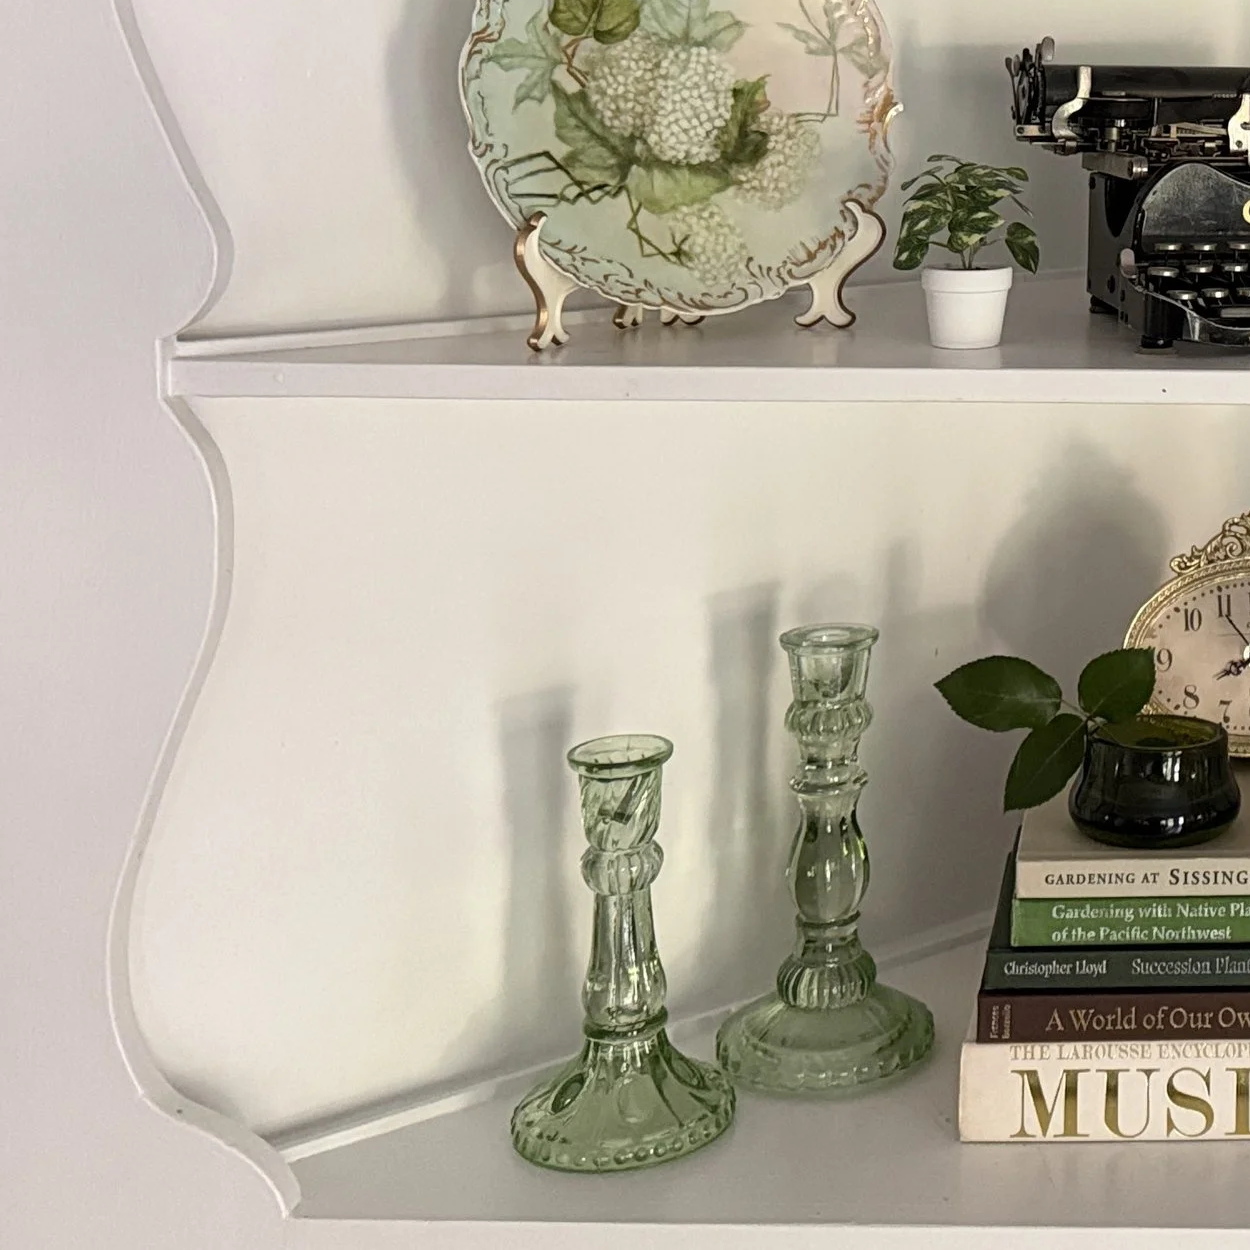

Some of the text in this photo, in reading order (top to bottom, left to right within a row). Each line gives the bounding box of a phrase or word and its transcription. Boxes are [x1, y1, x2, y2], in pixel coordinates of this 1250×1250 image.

[1217, 594, 1232, 618] 11
[1184, 608, 1202, 632] 10
[1157, 649, 1173, 671] 9
[1184, 685, 1200, 710] 8
[1218, 700, 1232, 723] 7
[1045, 872, 1136, 886] GARDENING
[1141, 872, 1160, 885] AT
[1052, 904, 1134, 923] Gardening
[1139, 903, 1172, 919] with
[1176, 902, 1226, 919] Native
[1052, 925, 1232, 942] of the Pacific Northwest
[1004, 959, 1107, 978] Christopher Lloyd
[1131, 957, 1211, 976] Succession
[1046, 1007, 1064, 1032] A
[1069, 1006, 1137, 1031] World
[1143, 1005, 1169, 1029] of
[1169, 1006, 1213, 1029] Our
[1009, 1044, 1050, 1061] THE
[1056, 1043, 1152, 1060] LAROUSSE
